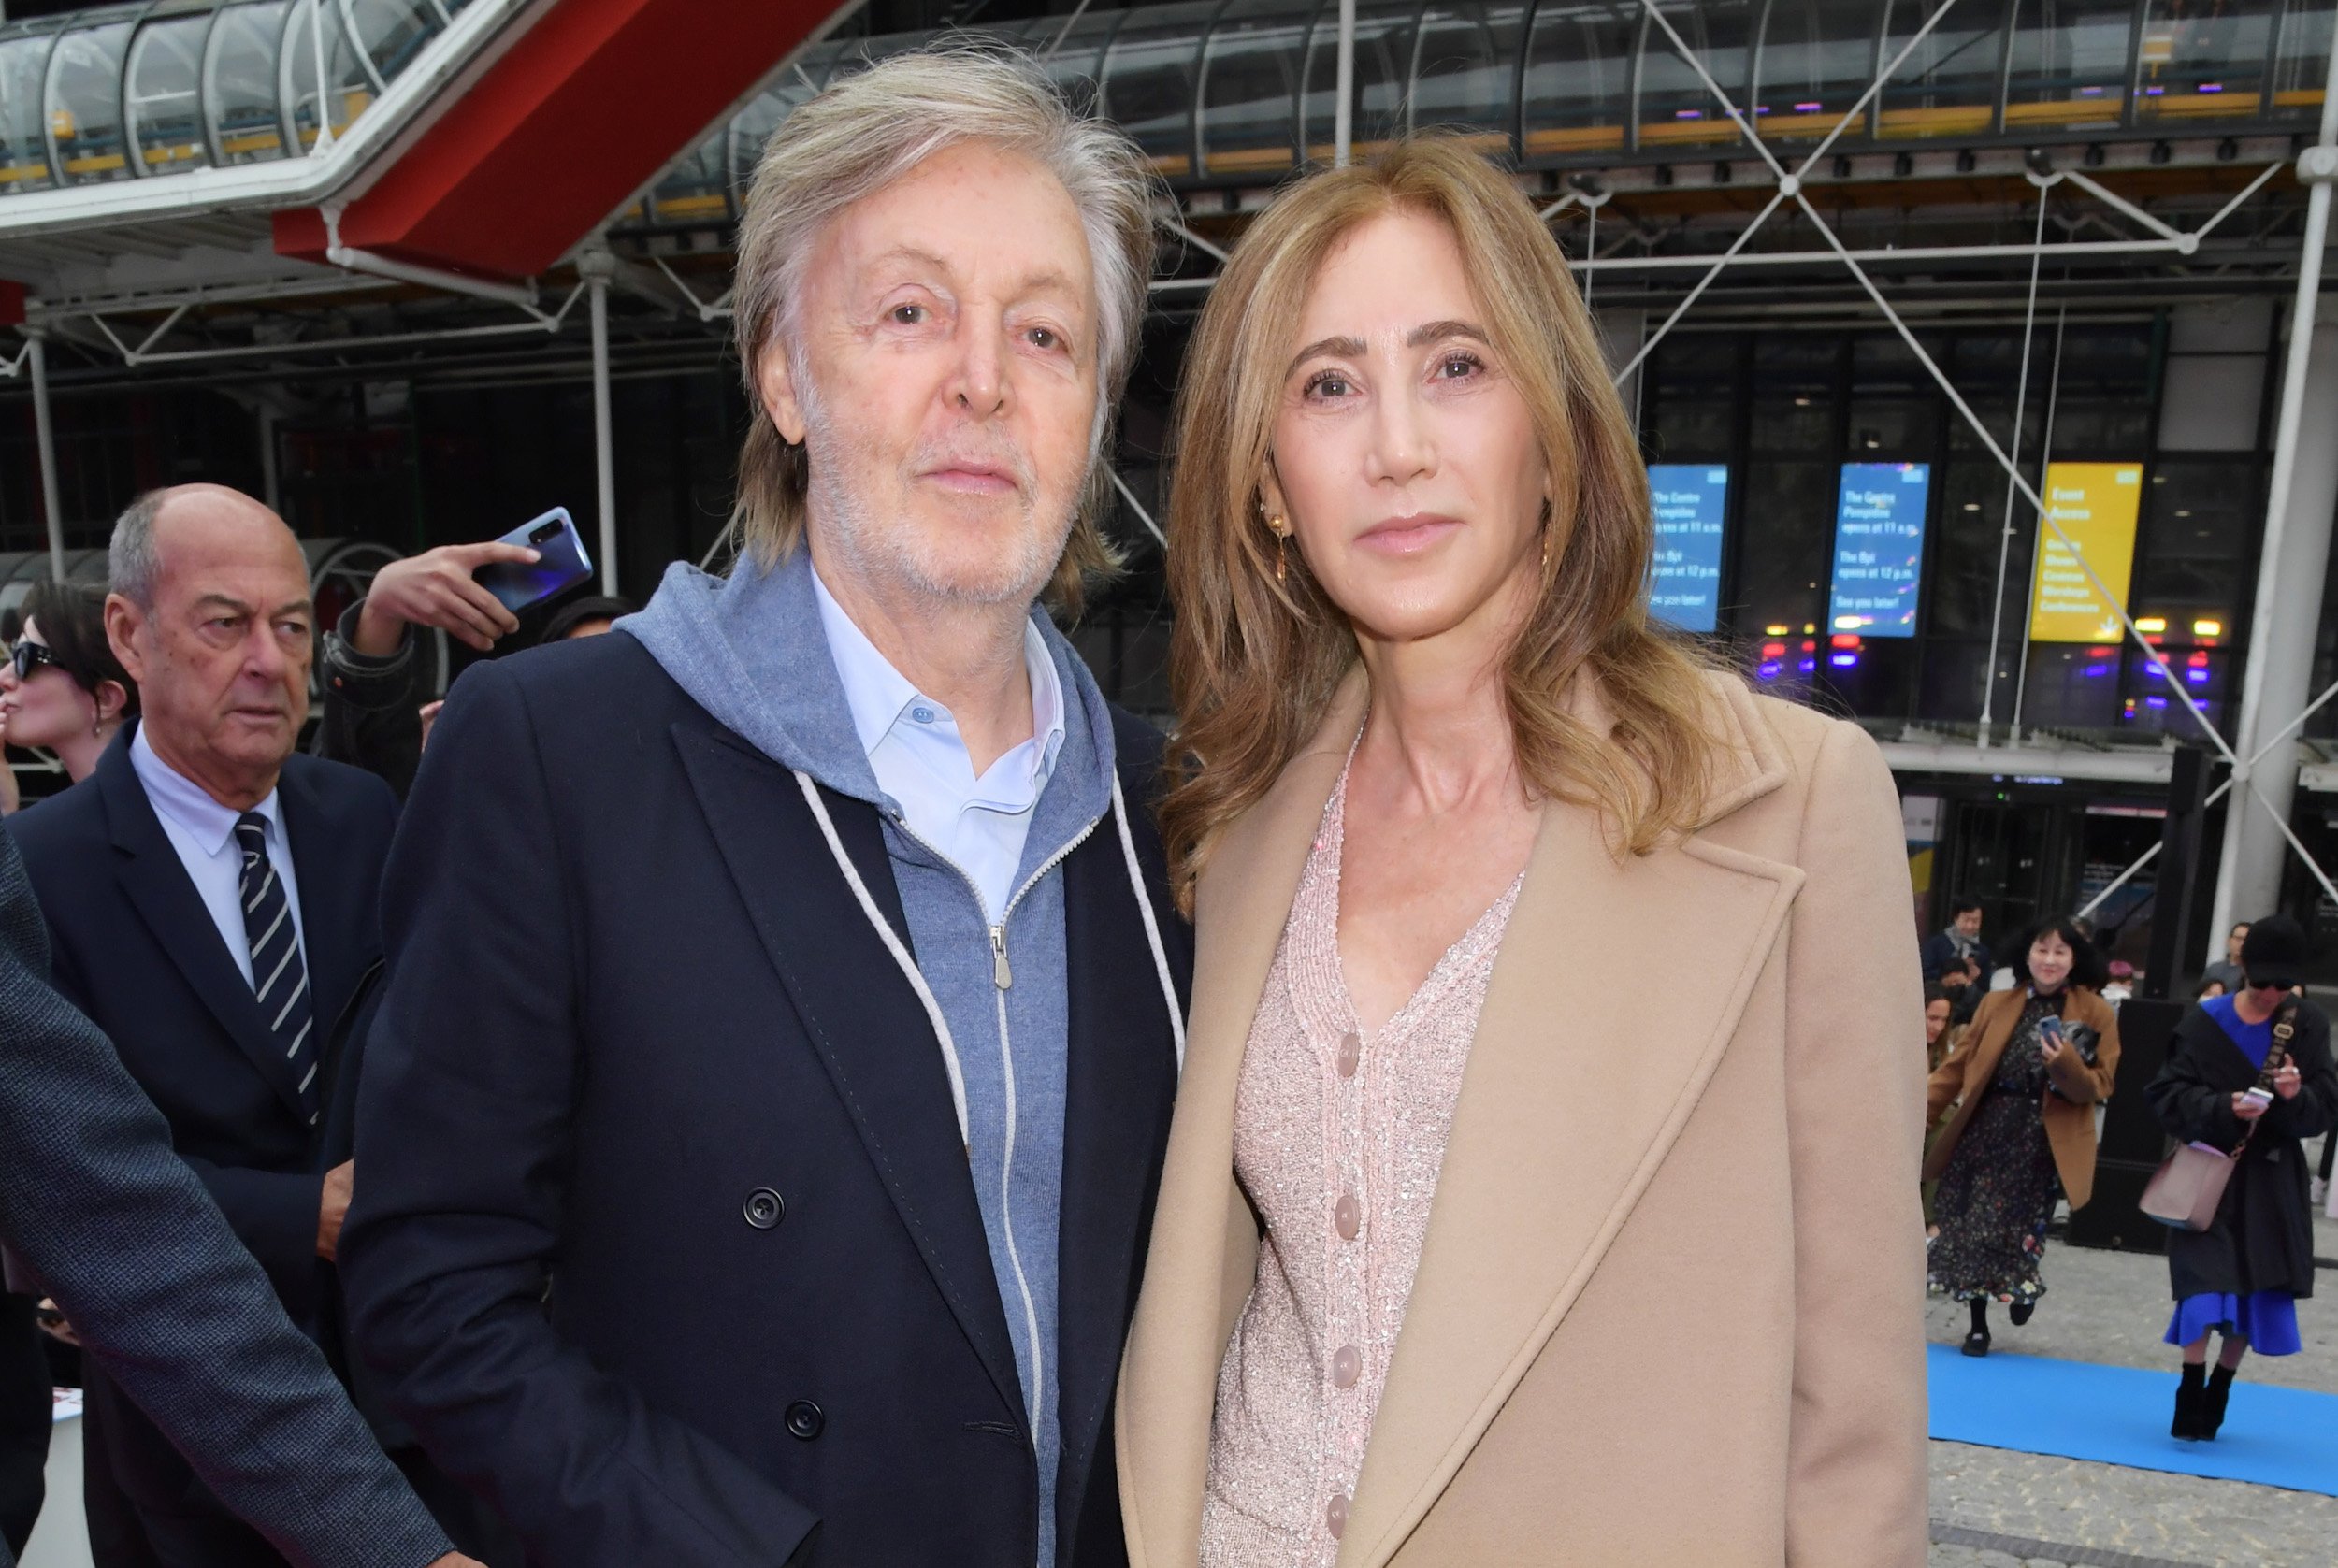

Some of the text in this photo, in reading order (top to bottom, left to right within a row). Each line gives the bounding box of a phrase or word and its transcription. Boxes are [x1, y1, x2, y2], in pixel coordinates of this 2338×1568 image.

[1846, 490, 1863, 503] The
[2052, 487, 2085, 502] Event
[1841, 523, 1870, 535] opens
[1871, 523, 1883, 534] at
[1884, 521, 1896, 533] 11
[1840, 551, 1857, 563] The
[1838, 568, 1867, 580] opens
[1868, 568, 1879, 579] at
[1881, 567, 1892, 579] 12
[1836, 595, 1854, 608] See
[1855, 597, 1872, 611] you
